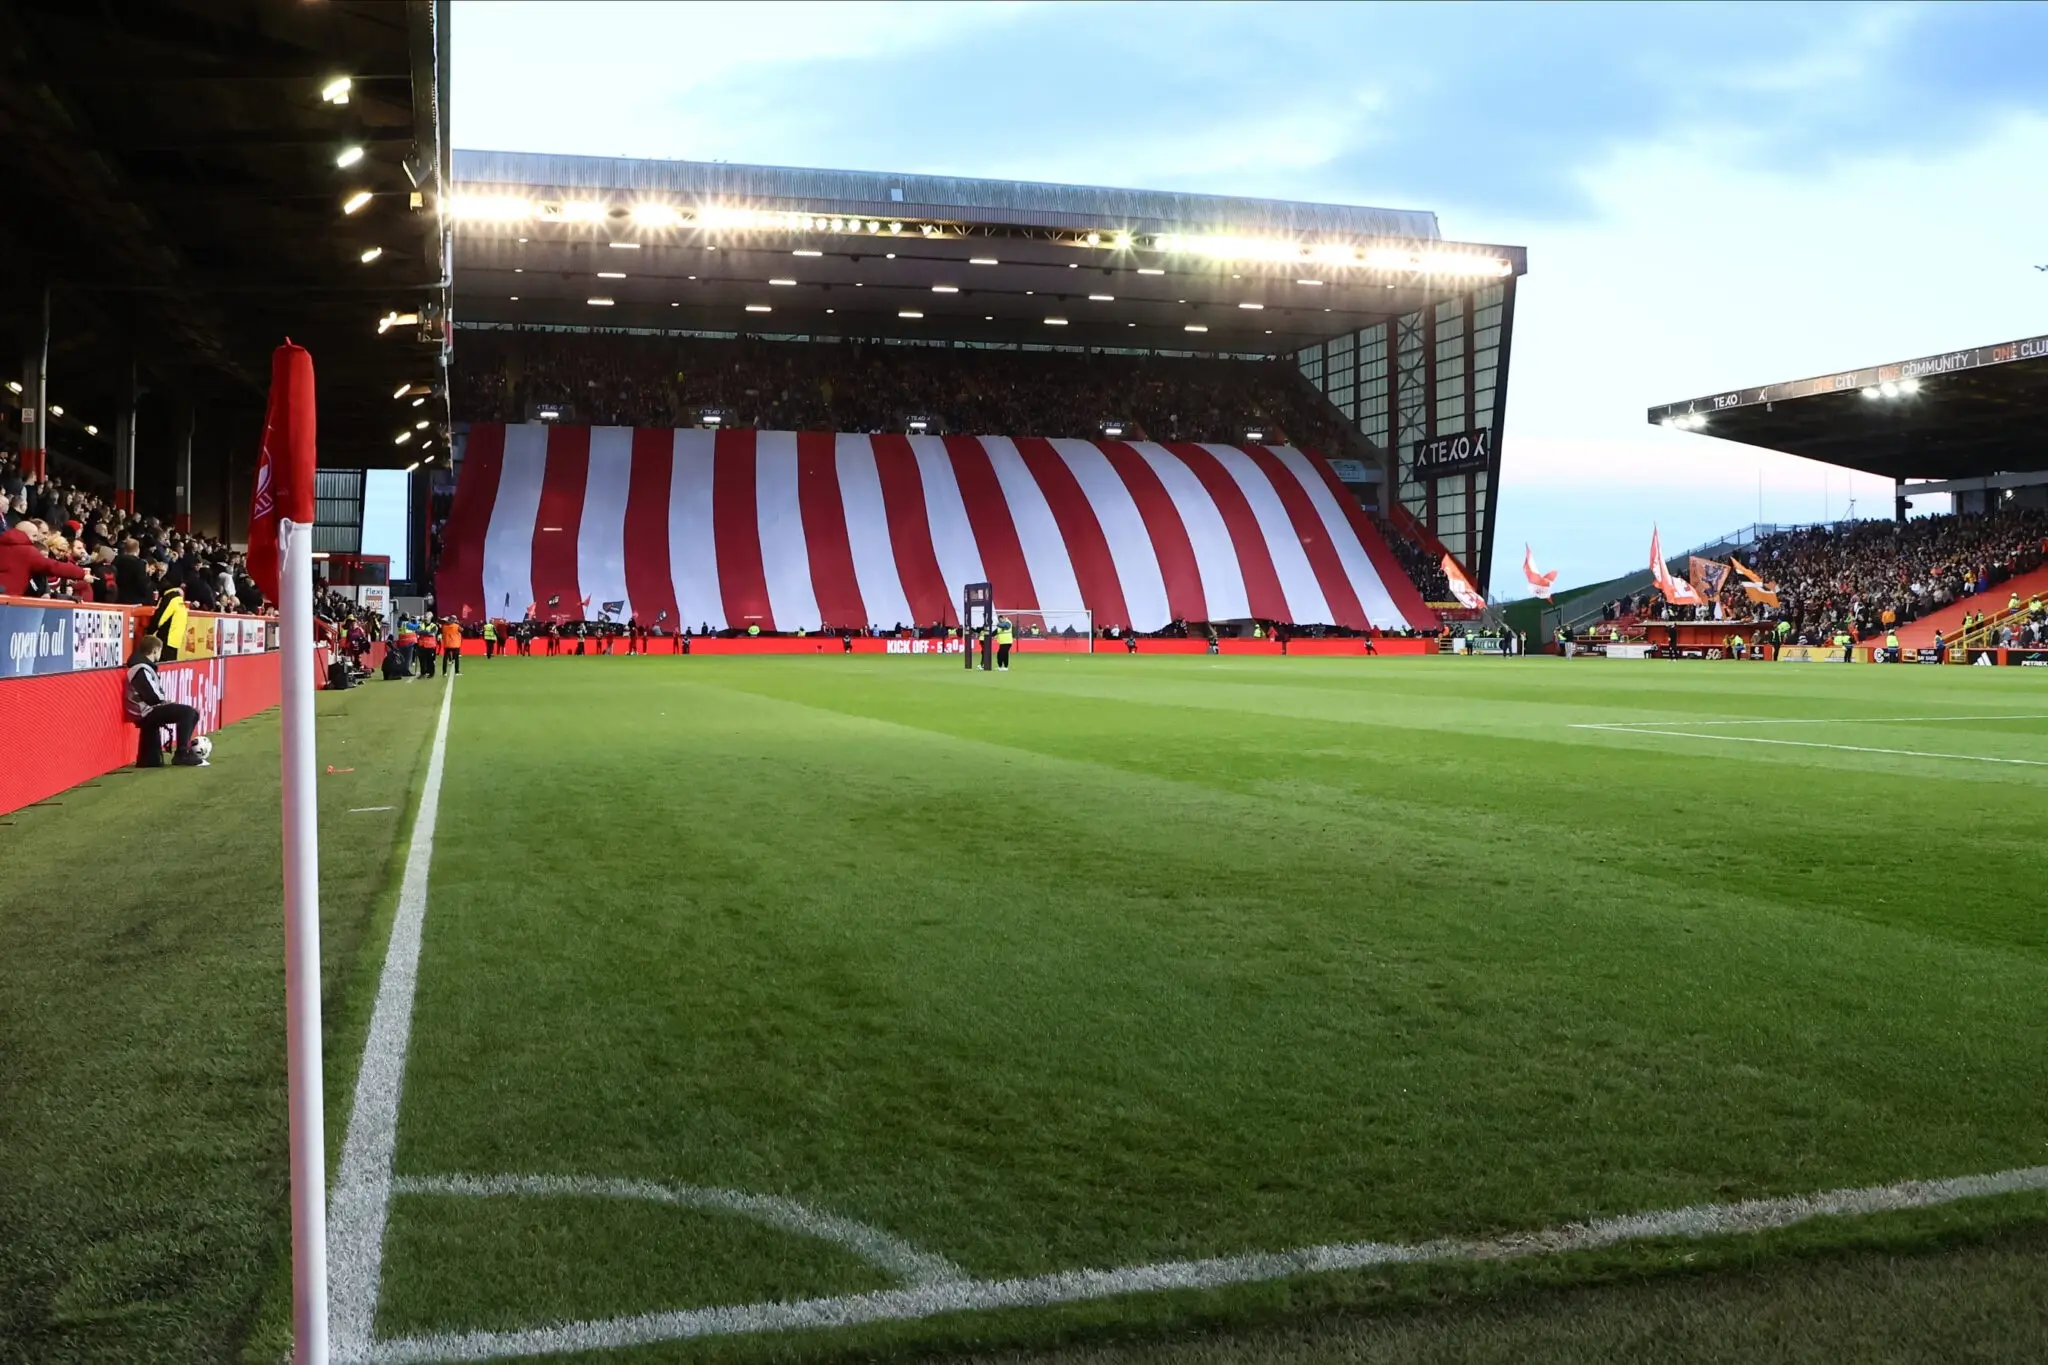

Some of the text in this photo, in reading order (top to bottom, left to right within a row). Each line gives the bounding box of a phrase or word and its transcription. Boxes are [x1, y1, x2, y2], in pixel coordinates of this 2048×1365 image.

[1992, 335, 2048, 361] ONE CLU
[1902, 353, 1969, 377] COMMUNITY
[1836, 374, 1858, 388] CITY
[1713, 394, 1738, 409] TEXO
[1429, 437, 1470, 463] TEXO
[10, 618, 66, 673] open to all
[90, 641, 119, 668] VENDING
[887, 639, 911, 653] KICK
[912, 639, 930, 653] OFF
